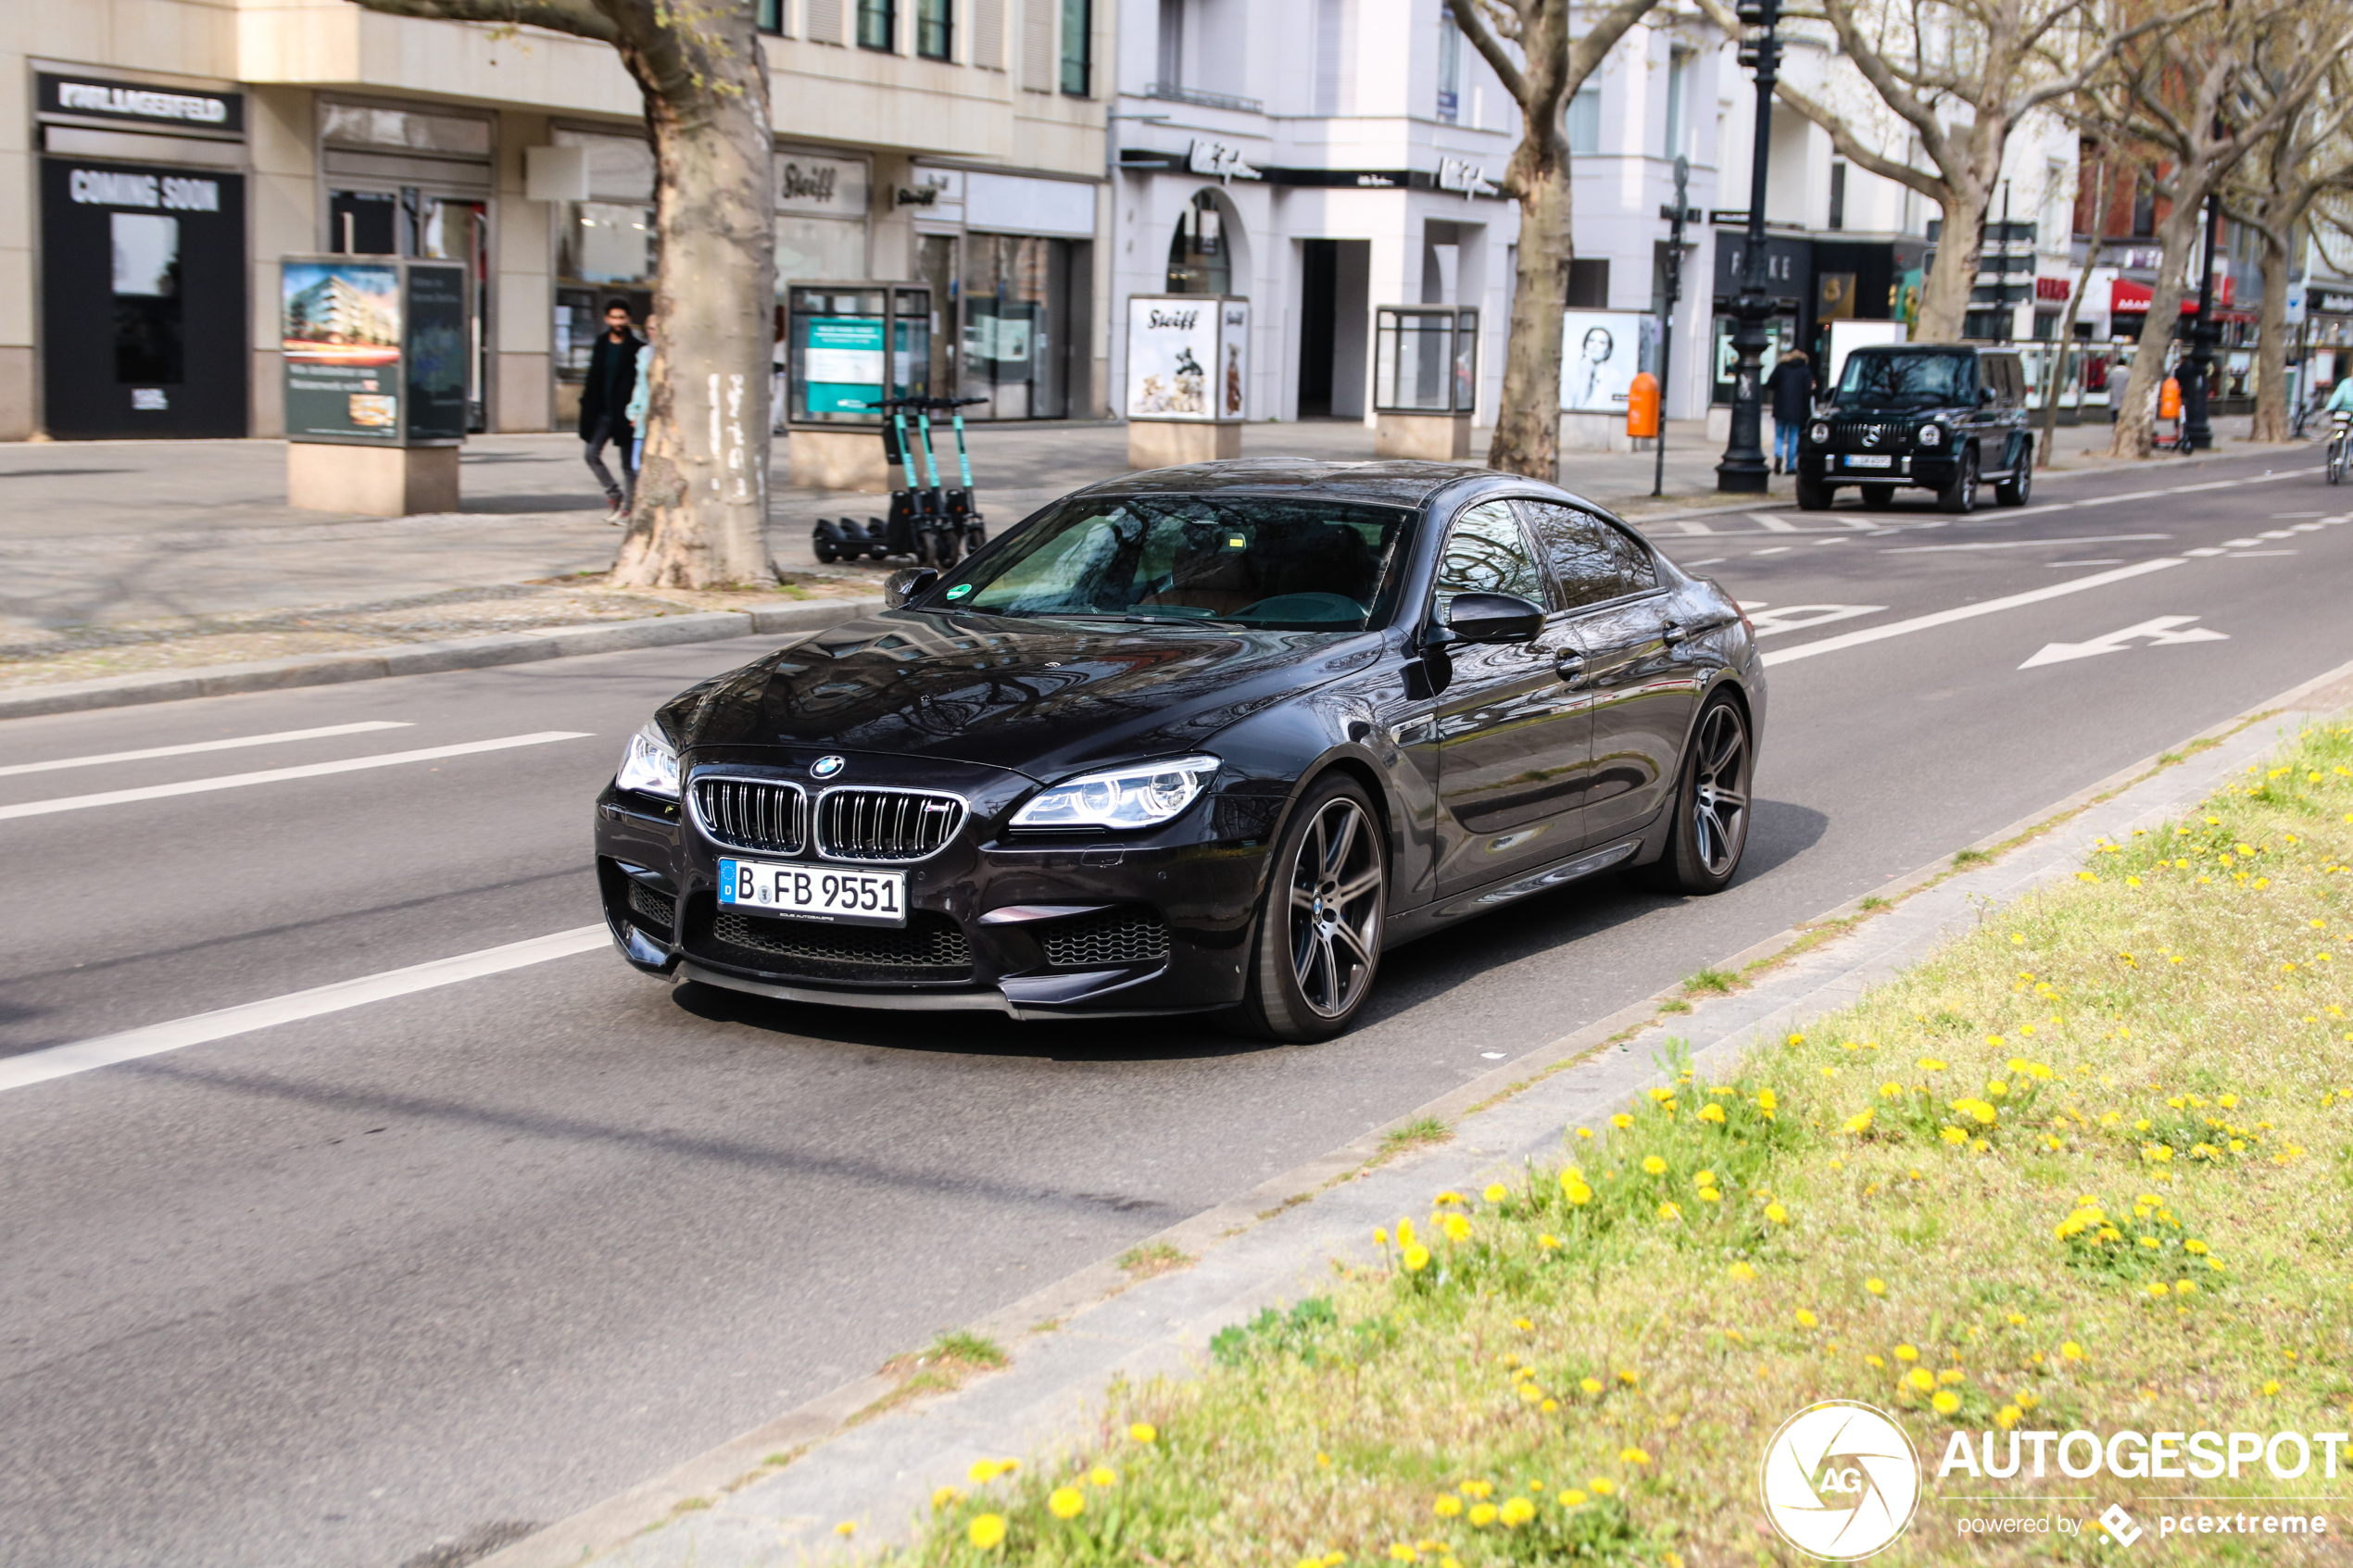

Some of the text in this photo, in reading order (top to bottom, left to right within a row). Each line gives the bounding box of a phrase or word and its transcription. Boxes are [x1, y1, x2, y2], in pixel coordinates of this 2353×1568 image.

[69, 169, 220, 212] COMING SOON
[1730, 251, 1792, 281] FKE
[1148, 309, 1200, 330] Steiff
[724, 884, 732, 896] D
[738, 867, 899, 913] B FB 9551
